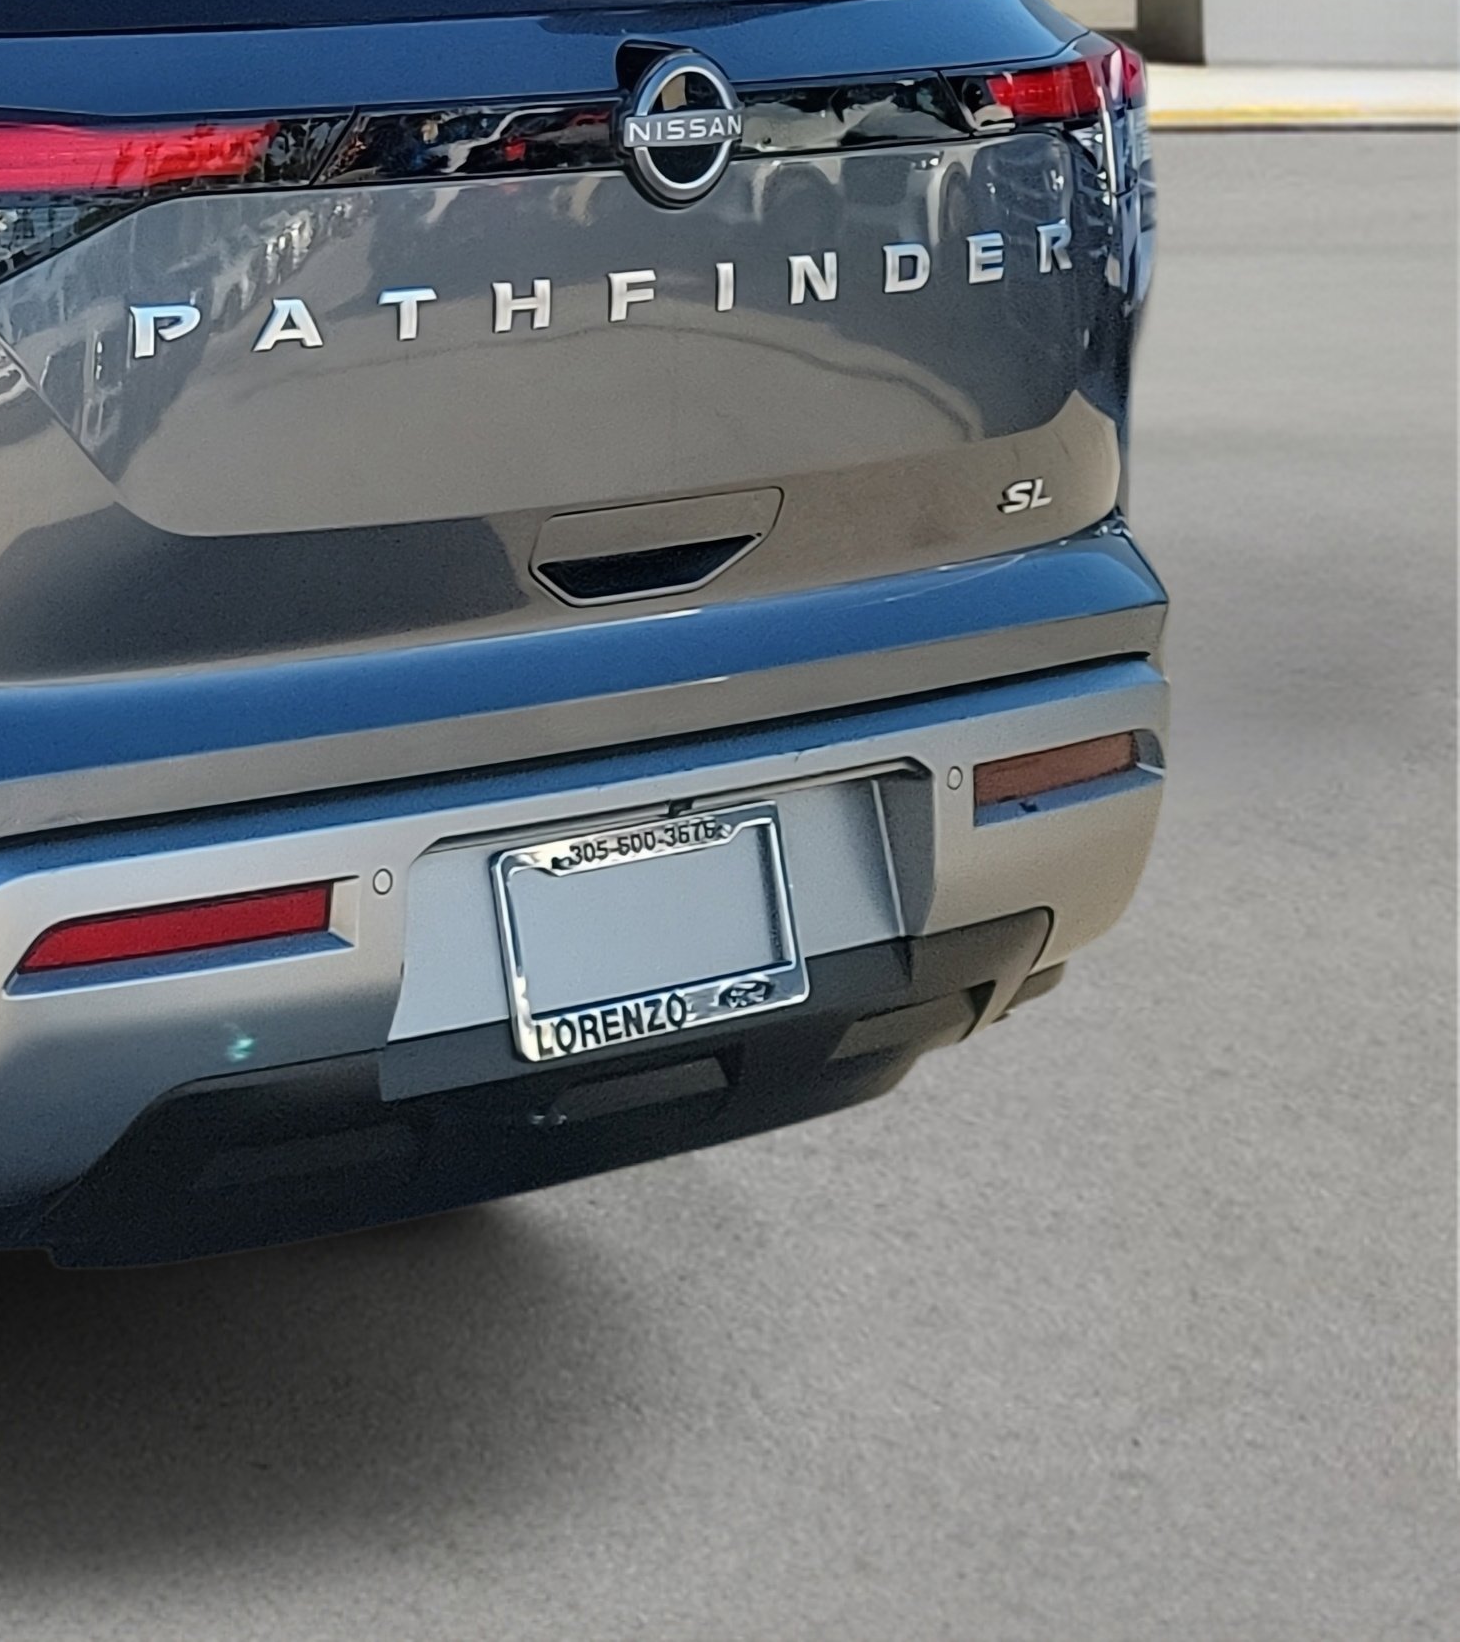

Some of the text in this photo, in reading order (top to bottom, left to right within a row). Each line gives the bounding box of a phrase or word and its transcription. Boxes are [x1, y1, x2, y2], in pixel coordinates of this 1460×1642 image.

[629, 114, 742, 143] NISSAN
[128, 221, 1074, 358] PATHFINDER
[996, 476, 1053, 515] SL
[536, 992, 687, 1057] LORENZO
